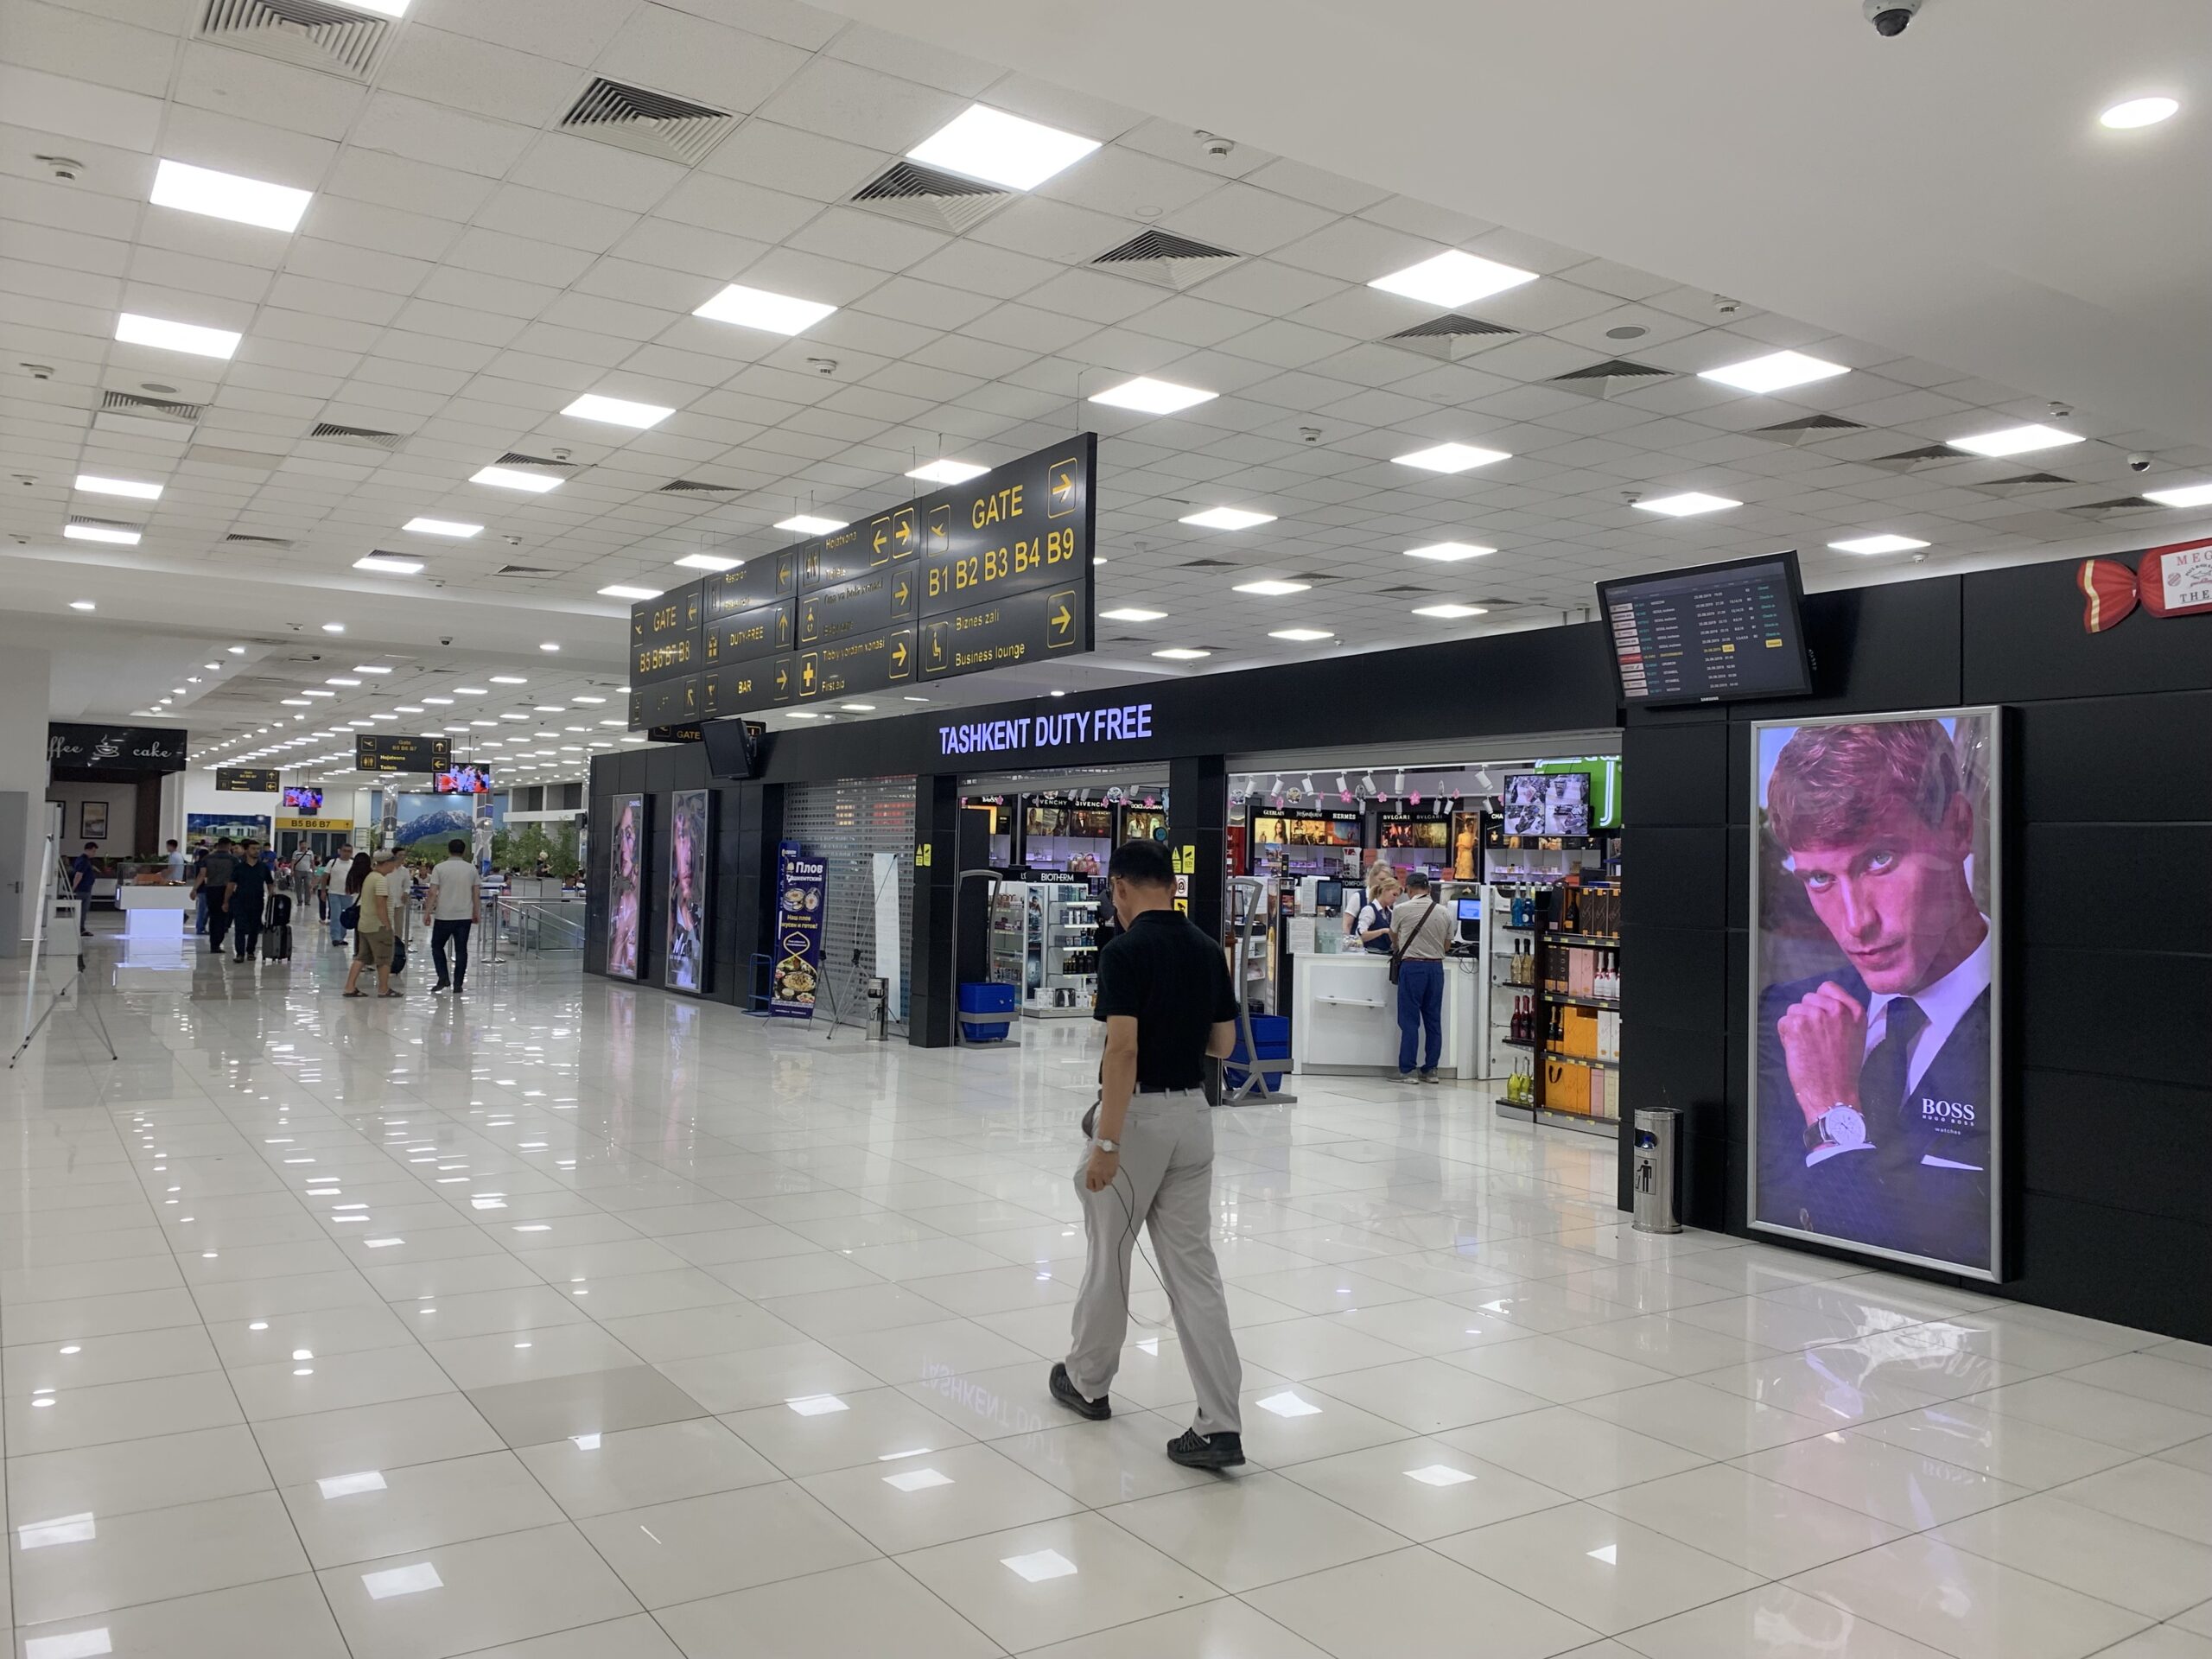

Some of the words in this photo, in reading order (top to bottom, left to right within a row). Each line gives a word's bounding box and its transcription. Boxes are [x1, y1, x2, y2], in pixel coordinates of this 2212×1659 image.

[971, 484, 1023, 530] GATE
[929, 566, 948, 597] B1
[956, 556, 978, 589] B2
[984, 547, 1008, 582] B3
[1014, 537, 1040, 573] B4
[1047, 527, 1074, 564] B9
[2179, 590, 2209, 602] THE
[653, 606, 677, 632] GATE
[956, 613, 982, 631] Biznes
[984, 608, 1000, 624] zali
[729, 626, 764, 646] DUTY-FREE
[639, 652, 650, 673] B5
[652, 649, 664, 670] B6
[665, 645, 676, 665] B7
[678, 639, 690, 663] B8
[956, 649, 993, 667] Business
[995, 643, 1026, 659] lounge
[738, 679, 752, 694] BAR
[677, 731, 701, 740] GATE
[939, 717, 1030, 754] TASHKENT
[1035, 711, 1090, 747] DUTY
[1094, 703, 1153, 741] FREE
[132, 741, 173, 758] cake
[291, 819, 303, 828] B5
[795, 861, 823, 874] Плов
[1040, 873, 1074, 881] BIOTHERM
[1922, 1097, 1975, 1121] BOSS
[1934, 1127, 1961, 1135] watches
[1951, 1118, 1974, 1127] BOSS
